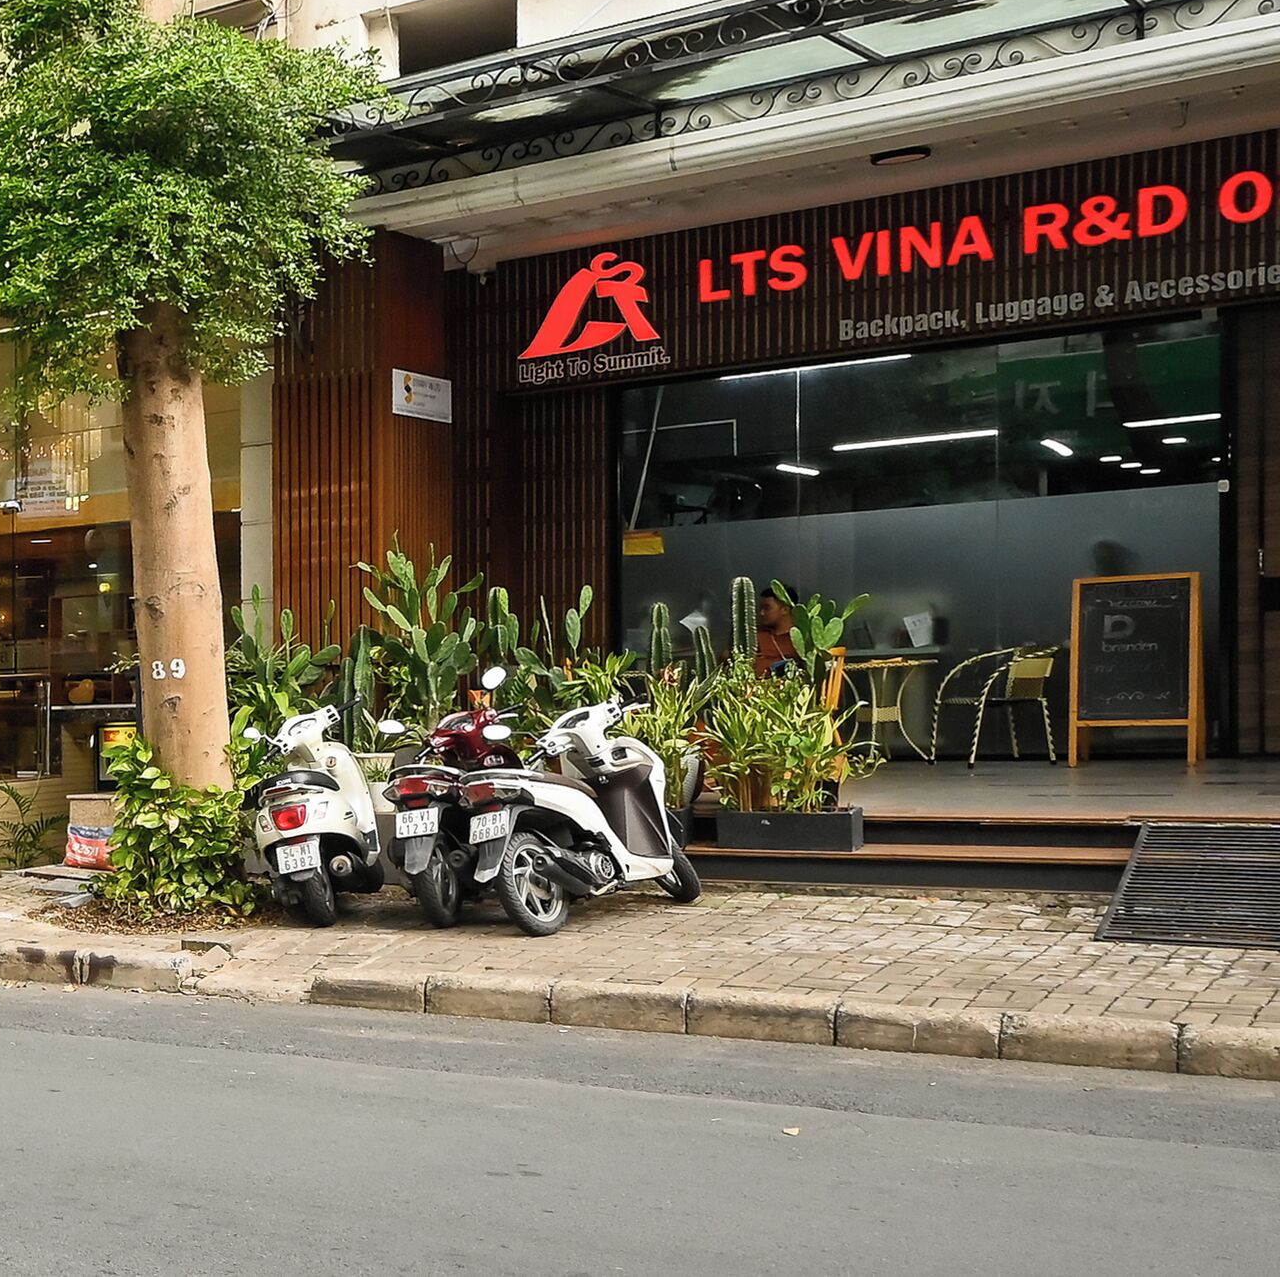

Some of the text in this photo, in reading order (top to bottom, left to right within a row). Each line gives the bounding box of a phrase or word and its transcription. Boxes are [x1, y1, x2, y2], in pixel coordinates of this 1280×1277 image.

[697, 243, 808, 304] LTS
[831, 215, 995, 282] VINA
[1022, 184, 1189, 255] R&D
[839, 307, 967, 341] Backpack,
[975, 291, 1085, 324] Luggage
[1094, 284, 1115, 308] &
[518, 346, 672, 385] Light To Summit.
[151, 658, 186, 679] 89
[284, 855, 314, 871] 6382
